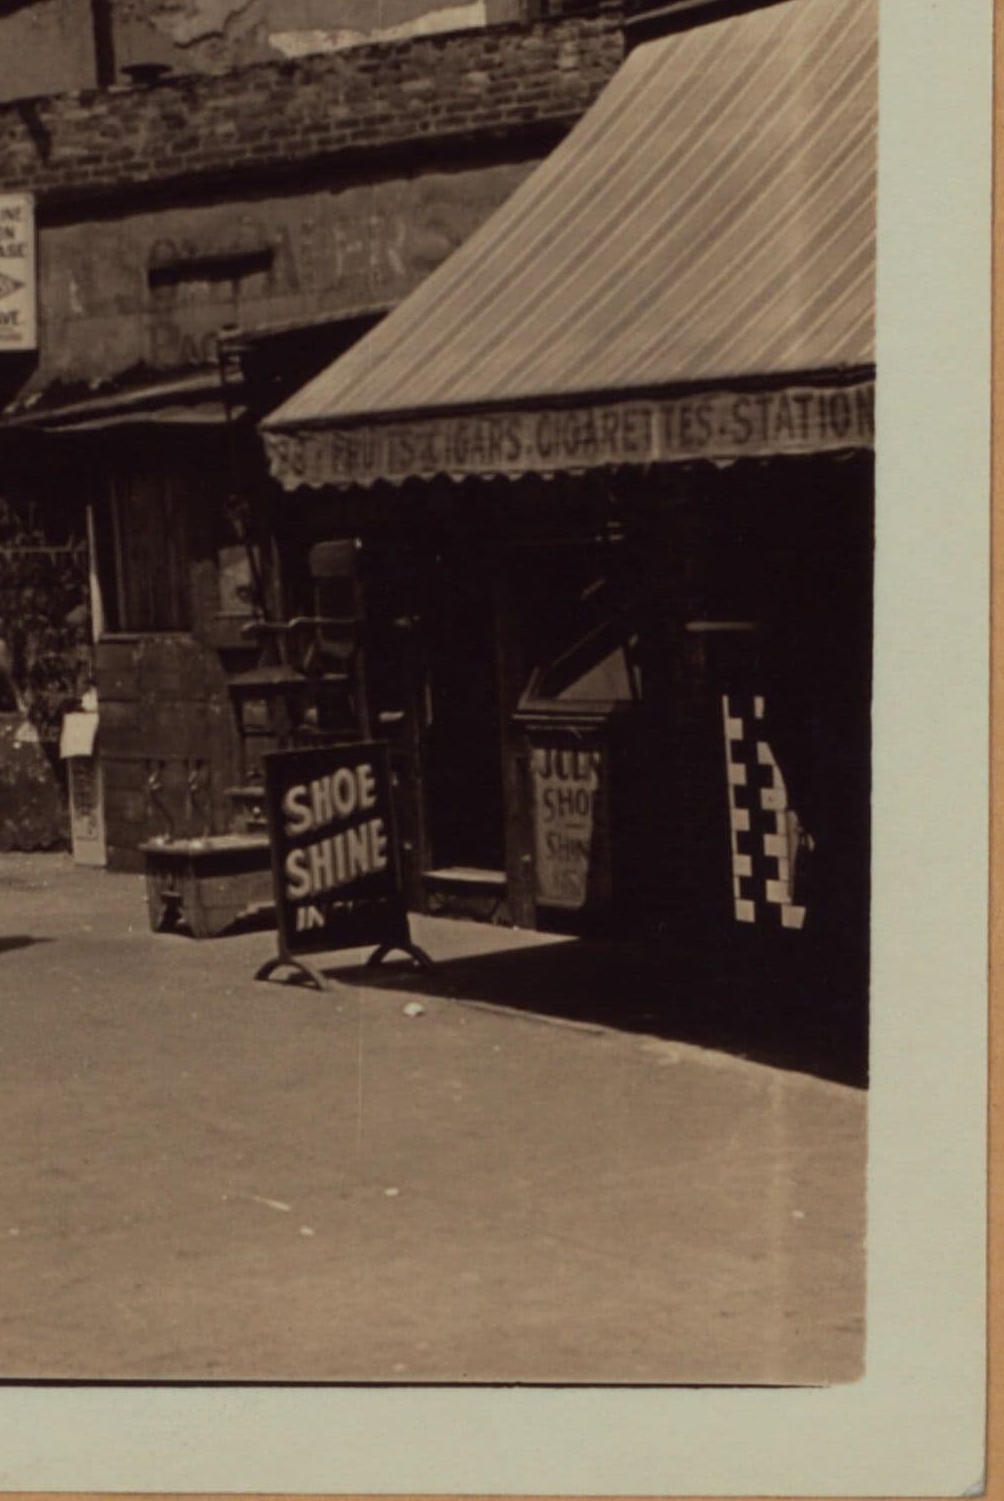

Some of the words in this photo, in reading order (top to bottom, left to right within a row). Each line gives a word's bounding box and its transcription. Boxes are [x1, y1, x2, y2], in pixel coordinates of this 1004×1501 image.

[281, 761, 378, 838] SHOE
[542, 787, 592, 822] SHO
[284, 816, 389, 900] SHINE
[546, 829, 590, 863] SHIN
